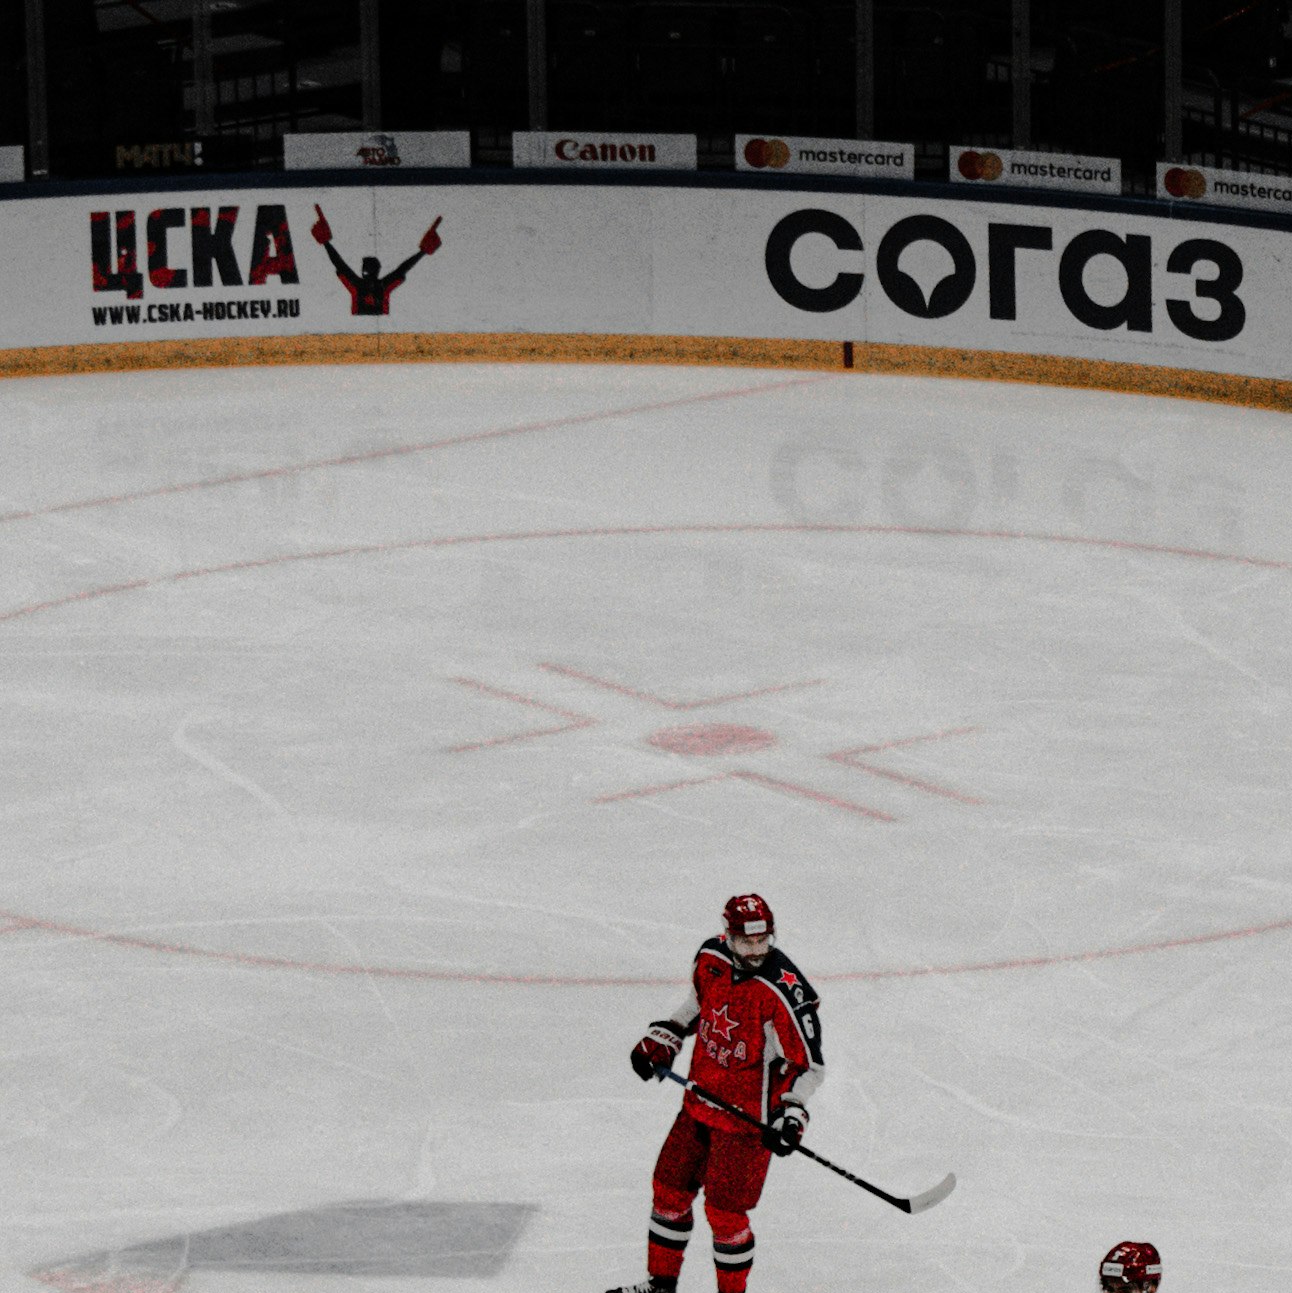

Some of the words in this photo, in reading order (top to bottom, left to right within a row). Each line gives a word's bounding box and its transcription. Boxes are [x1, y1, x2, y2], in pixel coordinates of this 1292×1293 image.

[554, 138, 657, 163] Canon
[798, 148, 905, 168] mastercard
[1010, 160, 1112, 183] mastercard
[90, 205, 300, 300] ЦСКА
[91, 298, 301, 326] WWW.CSKA-HOCKEY.RU
